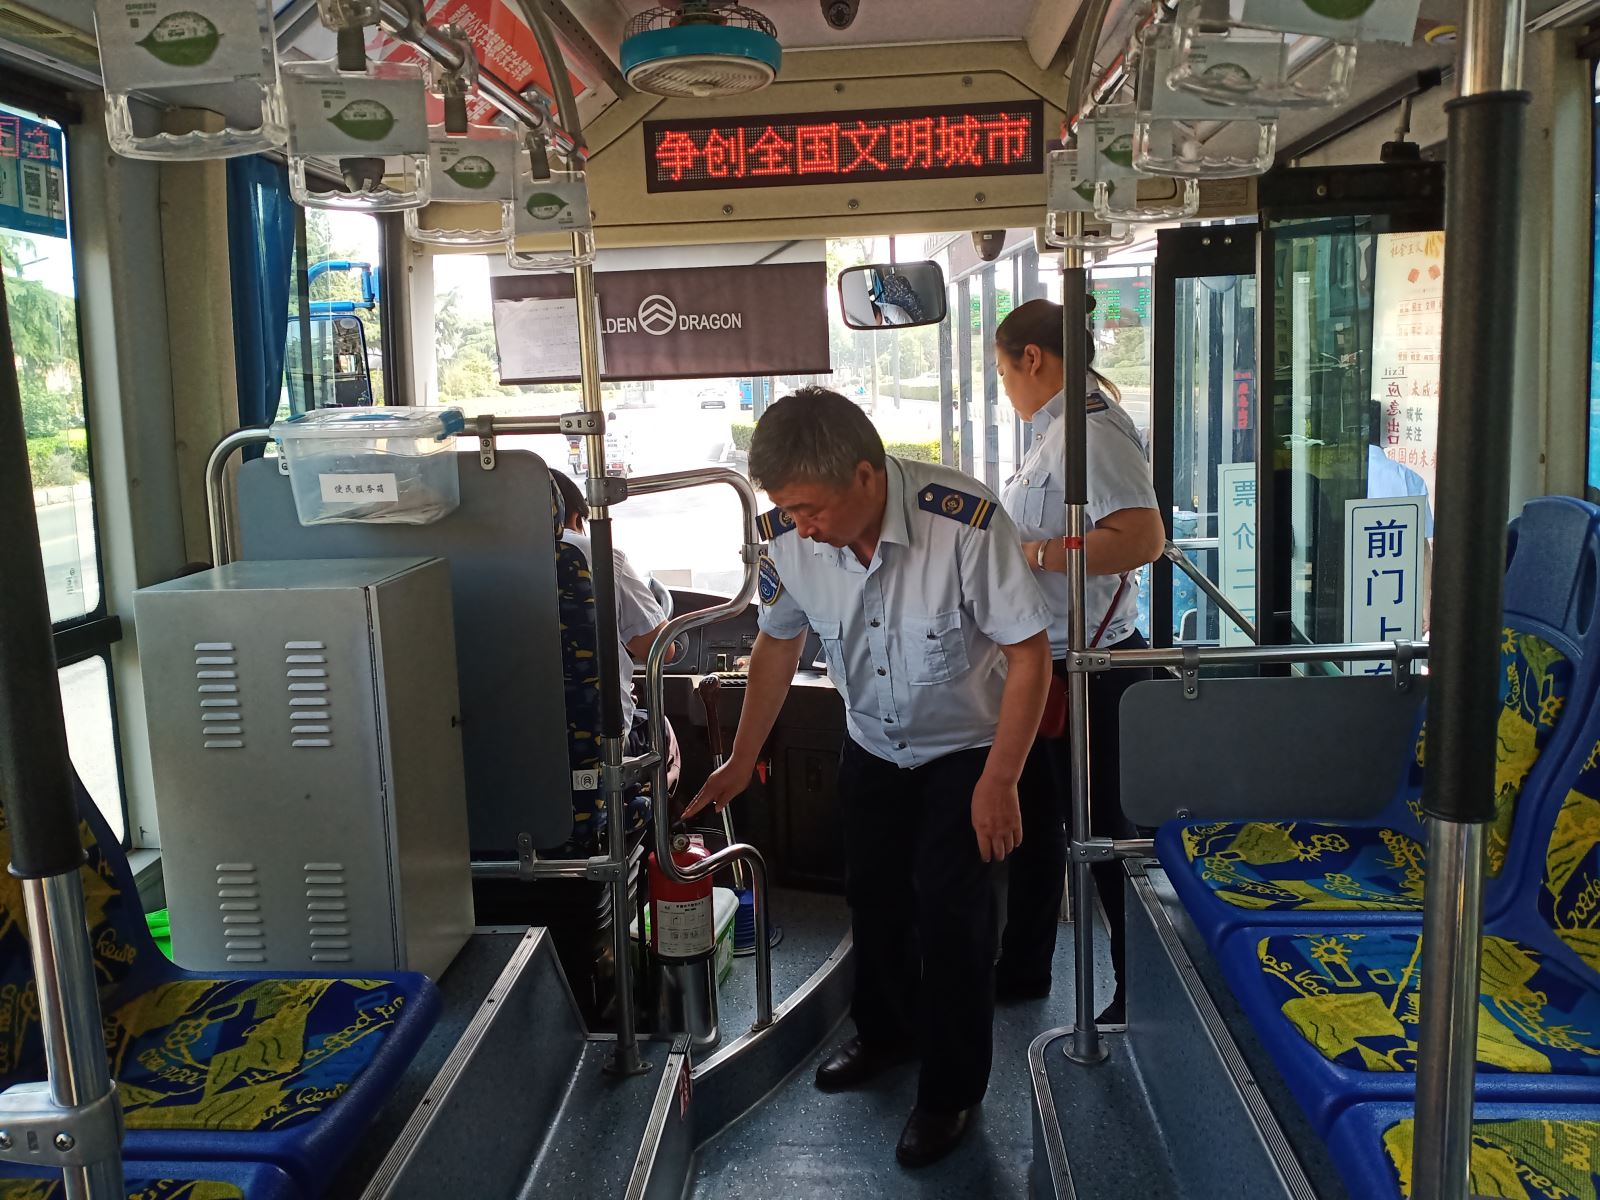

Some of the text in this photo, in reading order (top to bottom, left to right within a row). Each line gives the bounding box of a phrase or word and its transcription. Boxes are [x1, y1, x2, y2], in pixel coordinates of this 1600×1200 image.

[655, 112, 1028, 181] 争创全国文明城市
[679, 313, 742, 331] DRAGON
[334, 484, 384, 495] 便民服务箱
